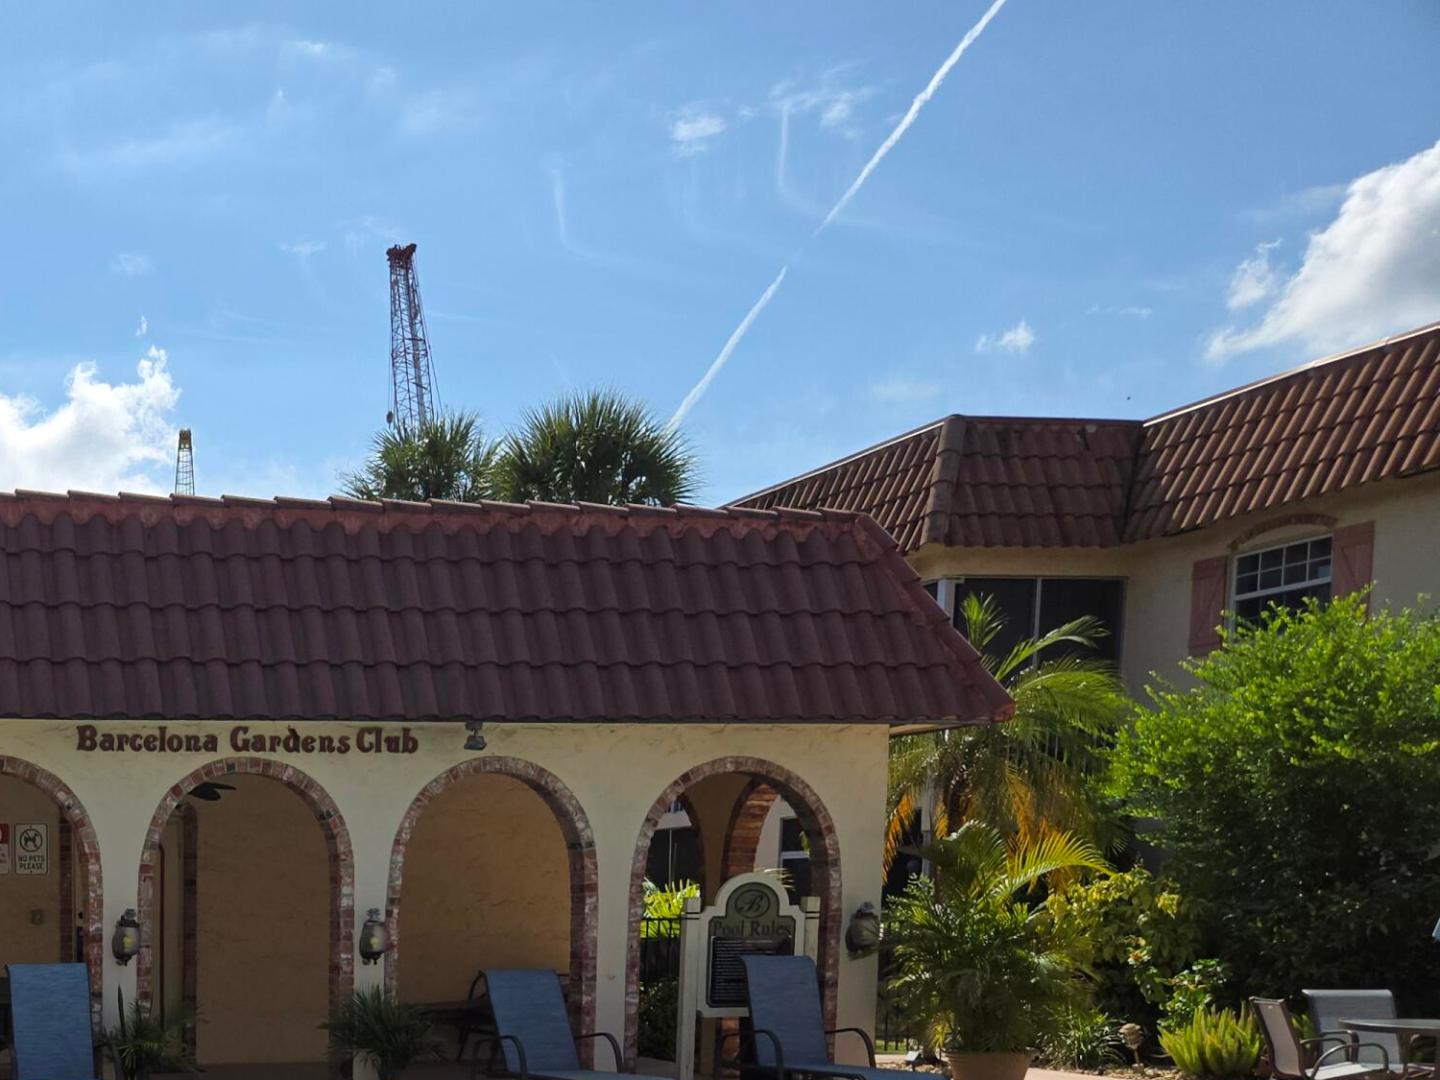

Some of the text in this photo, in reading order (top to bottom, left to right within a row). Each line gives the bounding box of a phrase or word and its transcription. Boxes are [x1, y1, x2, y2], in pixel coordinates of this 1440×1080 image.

[76, 725, 419, 754] Barcelona Gardens Club
[712, 921, 791, 936] Pool Rules
